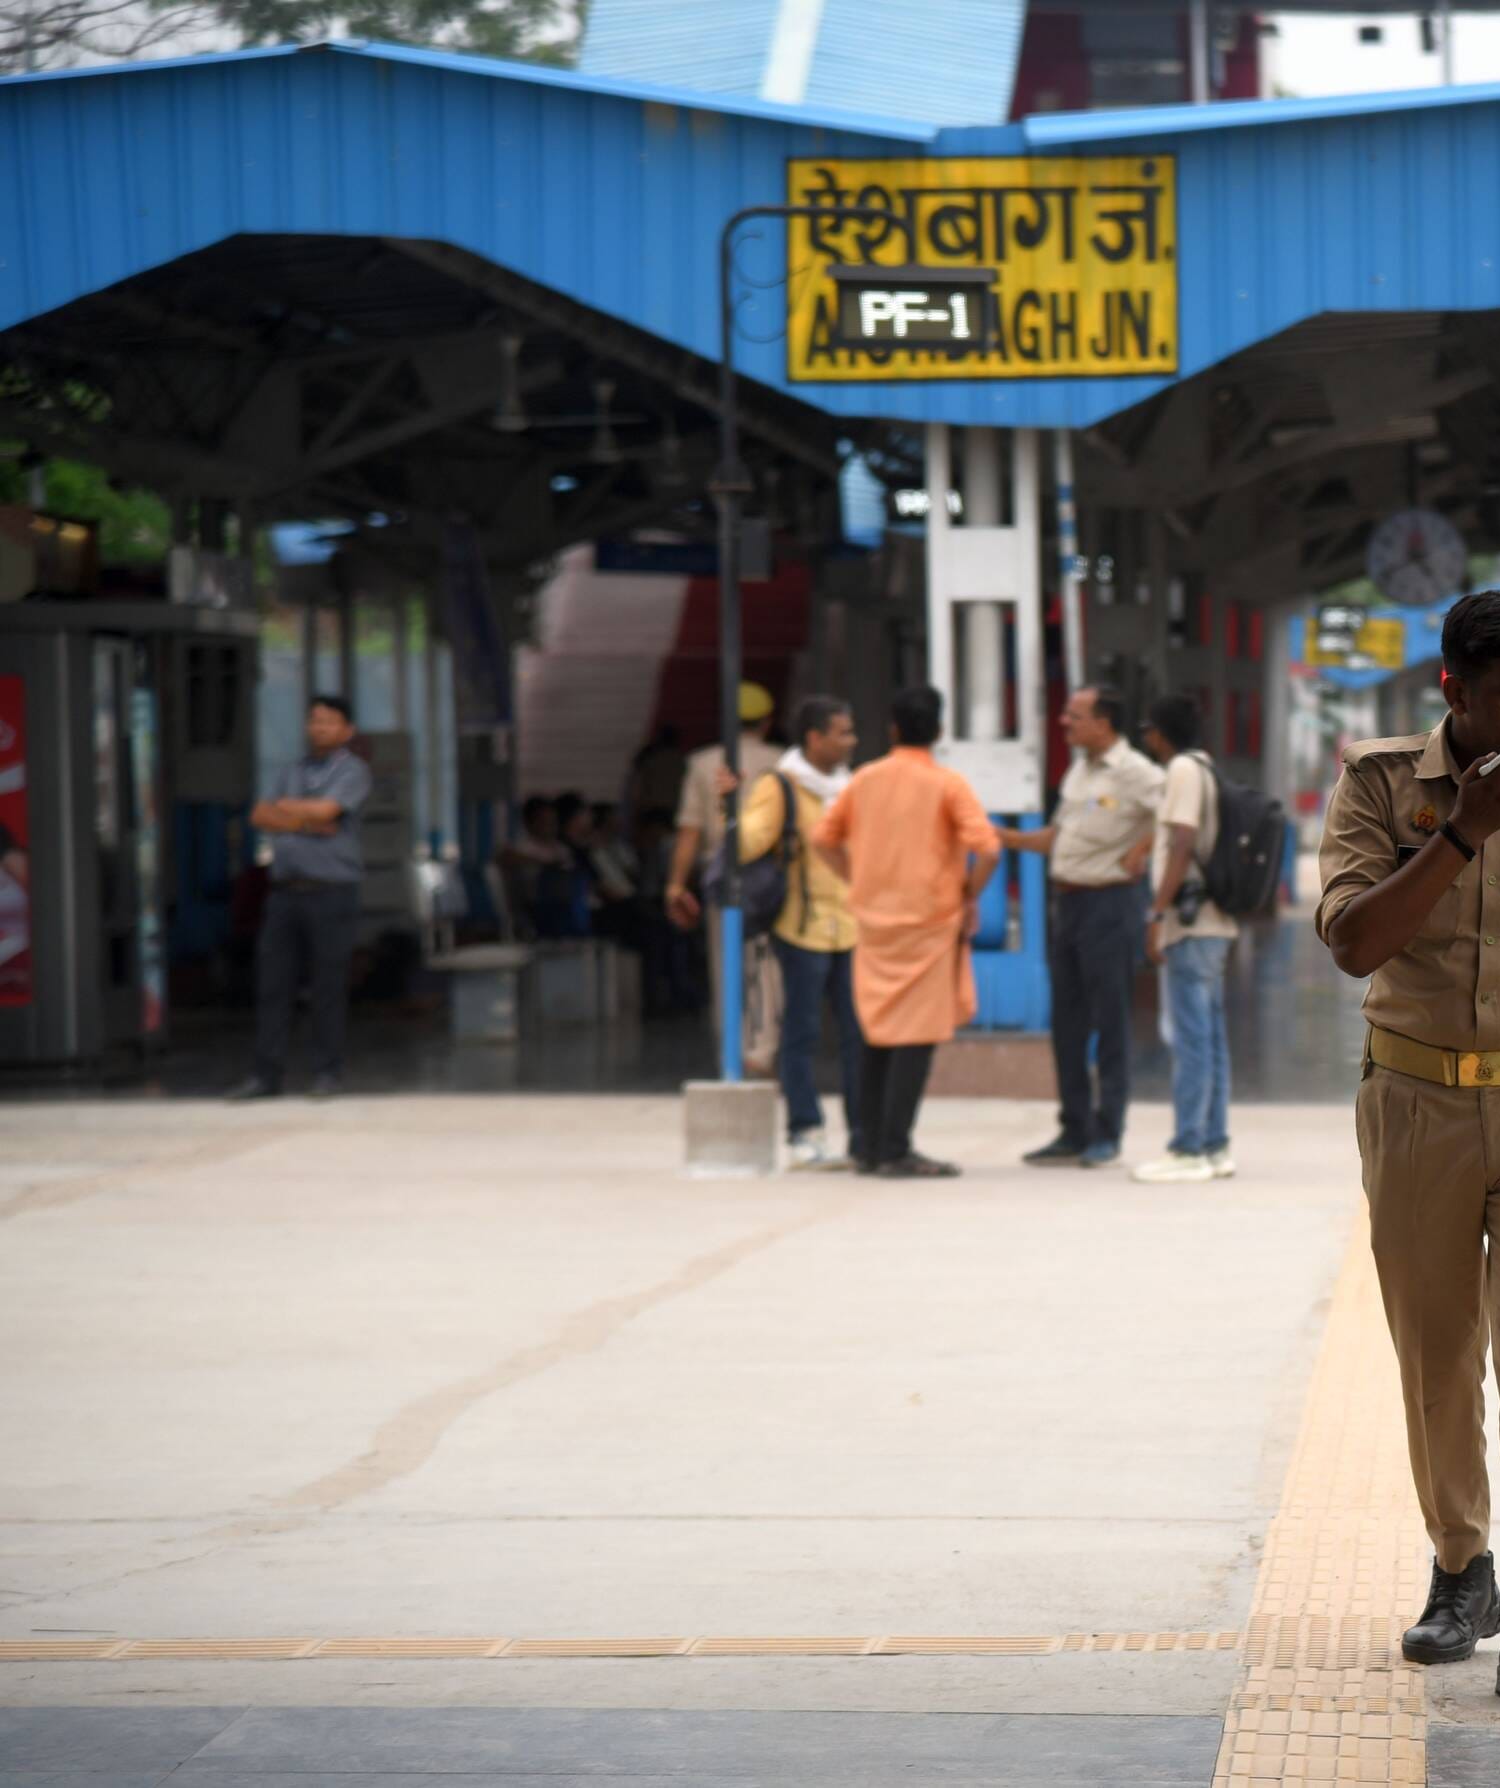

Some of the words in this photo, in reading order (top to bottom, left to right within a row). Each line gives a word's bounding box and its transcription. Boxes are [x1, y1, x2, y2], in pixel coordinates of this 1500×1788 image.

[806, 288, 1079, 367] AAGH
[1089, 290, 1168, 361] JN.
[859, 291, 970, 338] PF-1
